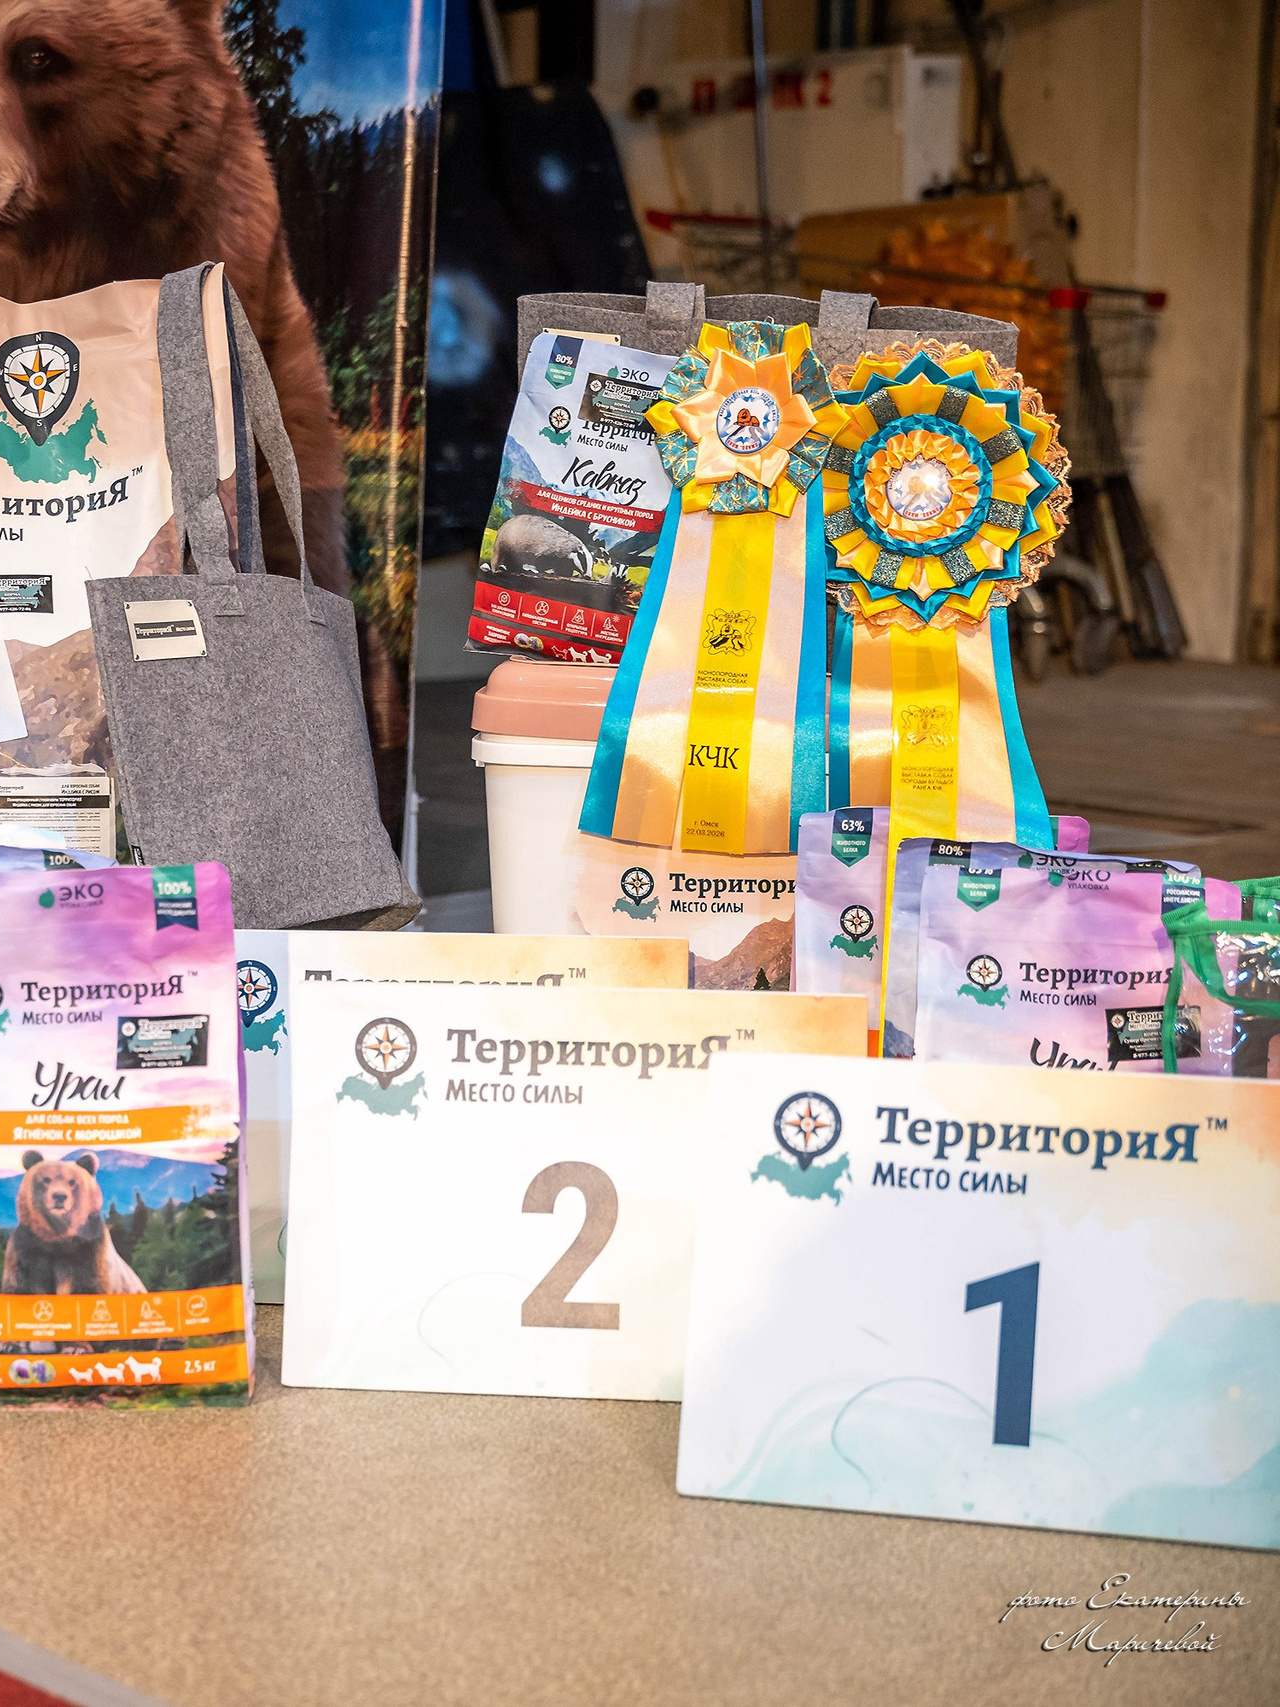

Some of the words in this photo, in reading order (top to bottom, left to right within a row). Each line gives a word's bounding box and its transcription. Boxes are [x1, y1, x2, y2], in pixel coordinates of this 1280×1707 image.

[36, 334, 42, 342] N
[555, 353, 573, 366] 80%
[72, 364, 78, 372] E
[620, 367, 650, 382] ЭКО
[36, 419, 42, 427] S
[561, 456, 647, 506] Кавказ
[536, 489, 551, 498] ДЛЯ
[551, 492, 577, 504] ЩЕНКОВ
[577, 498, 602, 510] СРЕДНИХ
[607, 504, 634, 517] КРУПНЫХ
[634, 509, 654, 520] ПОРОД
[551, 502, 586, 518] ИНДЕЙКА
[587, 512, 592, 520] С
[593, 511, 636, 528] БРУСНИКОЙ
[698, 669, 748, 678] МОНОПОРОДНАЯ
[687, 743, 740, 770] КЧК
[700, 819, 719, 828] Омск
[840, 819, 865, 833] 63%
[938, 844, 964, 857] 80%
[58, 883, 104, 901] ЭКО
[157, 881, 192, 897] 100%
[1067, 883, 1110, 891] УПАКОВКА
[20, 974, 184, 1007] ТерриториЯ
[446, 1028, 732, 1079] ТерриториЯ
[31, 1060, 126, 1110] Урал
[25, 1114, 45, 1125] ДЛЯ
[98, 1113, 130, 1125] ПОРОД
[74, 1126, 142, 1142] МОРОШКОЙ
[875, 1106, 1199, 1170] ТерриториЯ
[520, 1160, 620, 1330] 2
[963, 1260, 1040, 1448] 1
